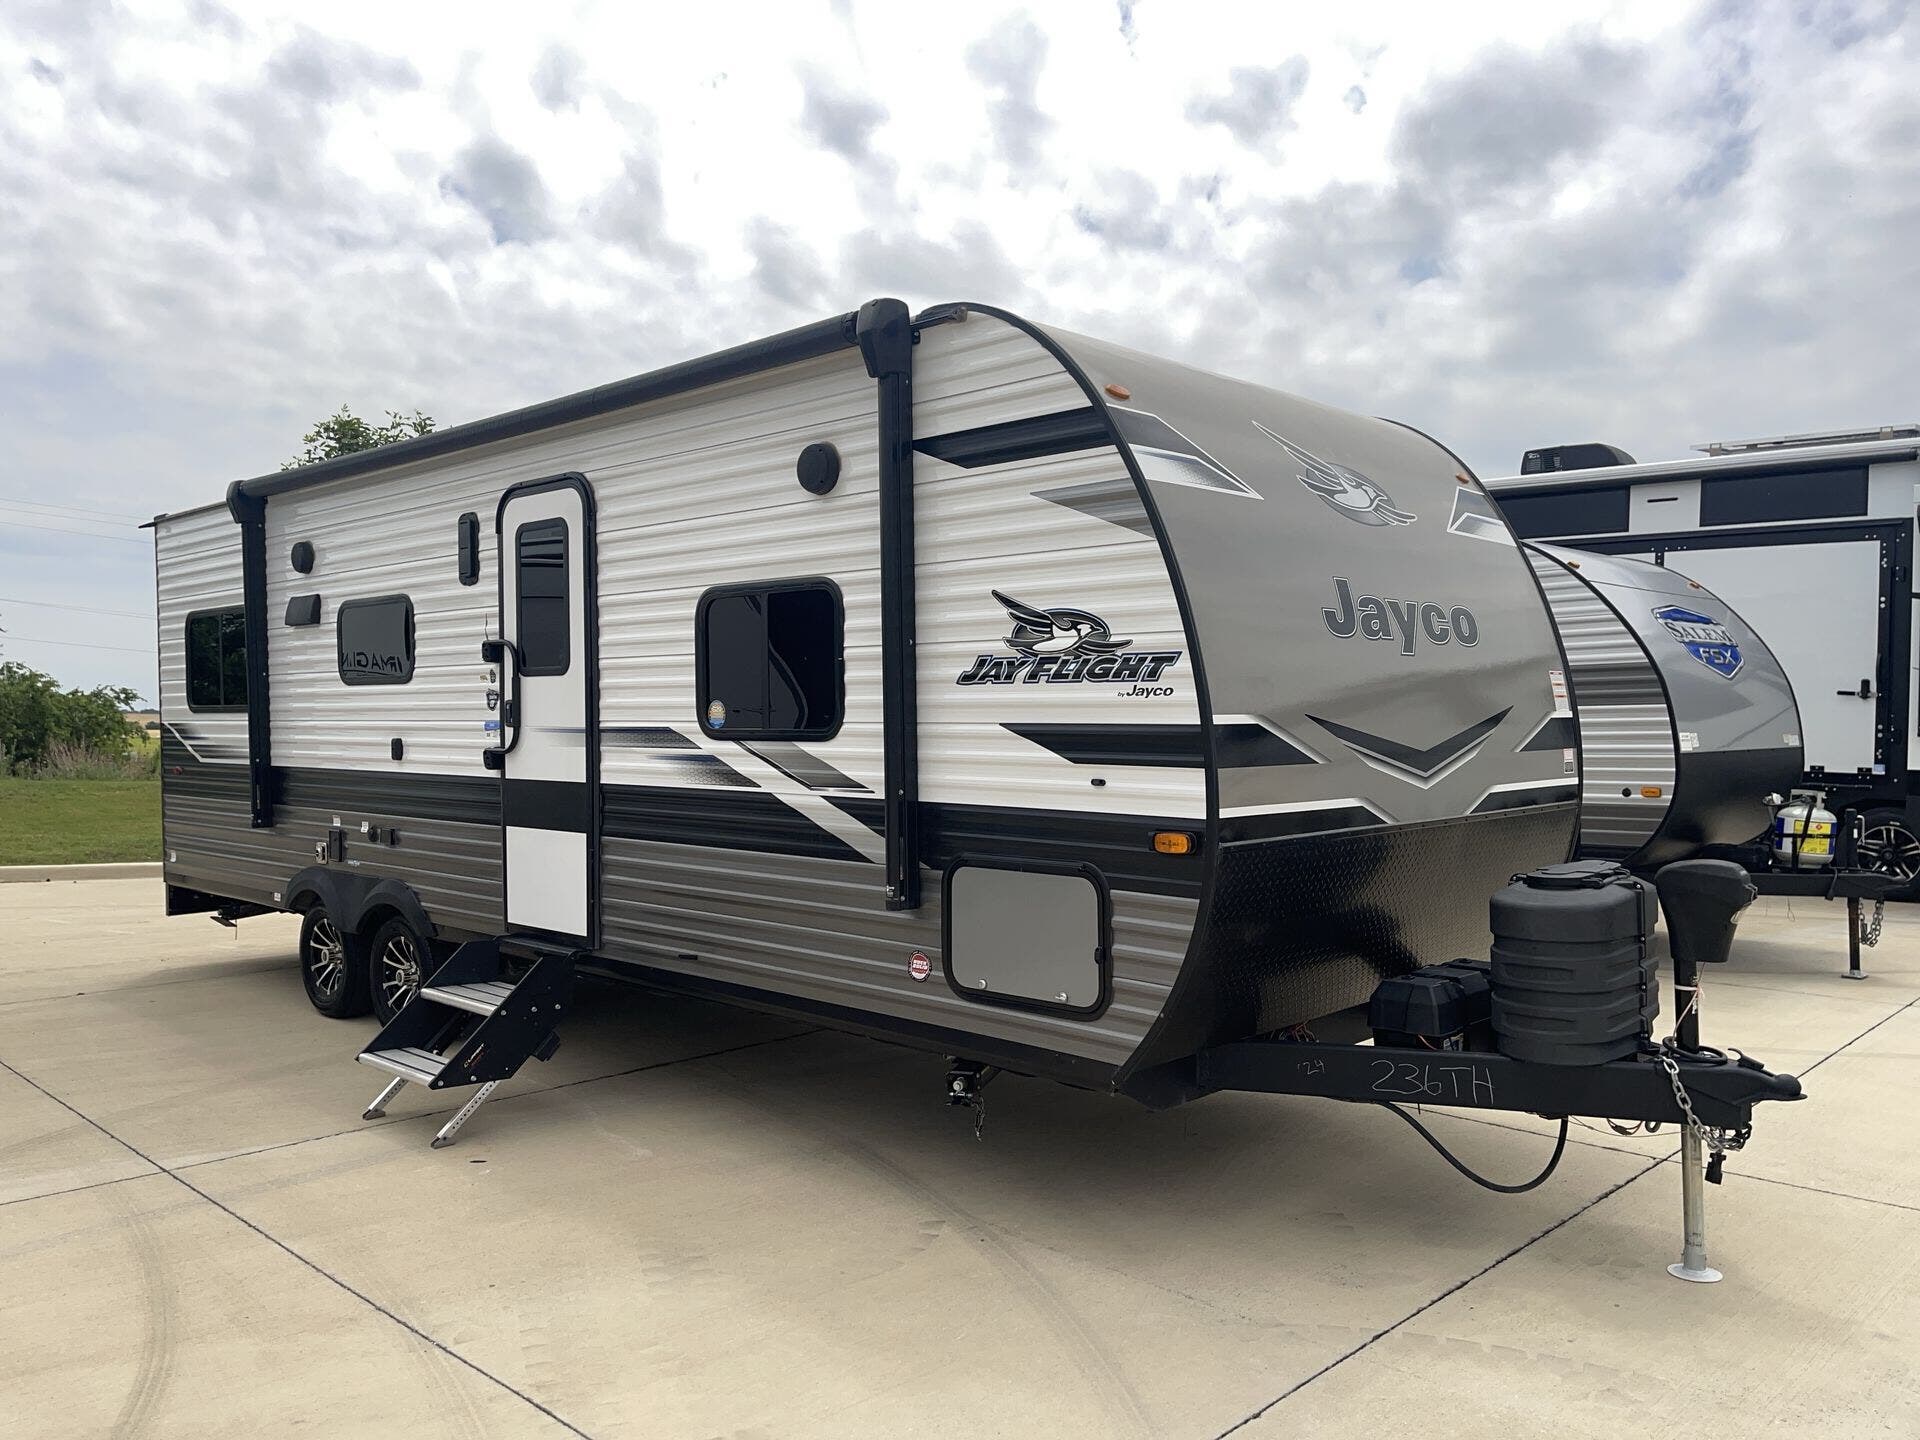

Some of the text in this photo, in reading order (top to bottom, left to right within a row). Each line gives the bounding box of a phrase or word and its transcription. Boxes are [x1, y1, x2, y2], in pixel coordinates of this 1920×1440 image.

[1321, 575, 1480, 656] Jayco
[1664, 621, 1735, 644] SALEM
[957, 651, 1182, 685] JAY FLIGHT
[1699, 647, 1736, 665] FSX
[1117, 685, 1174, 698] by Jayco
[1371, 1060, 1494, 1104] 236TH
